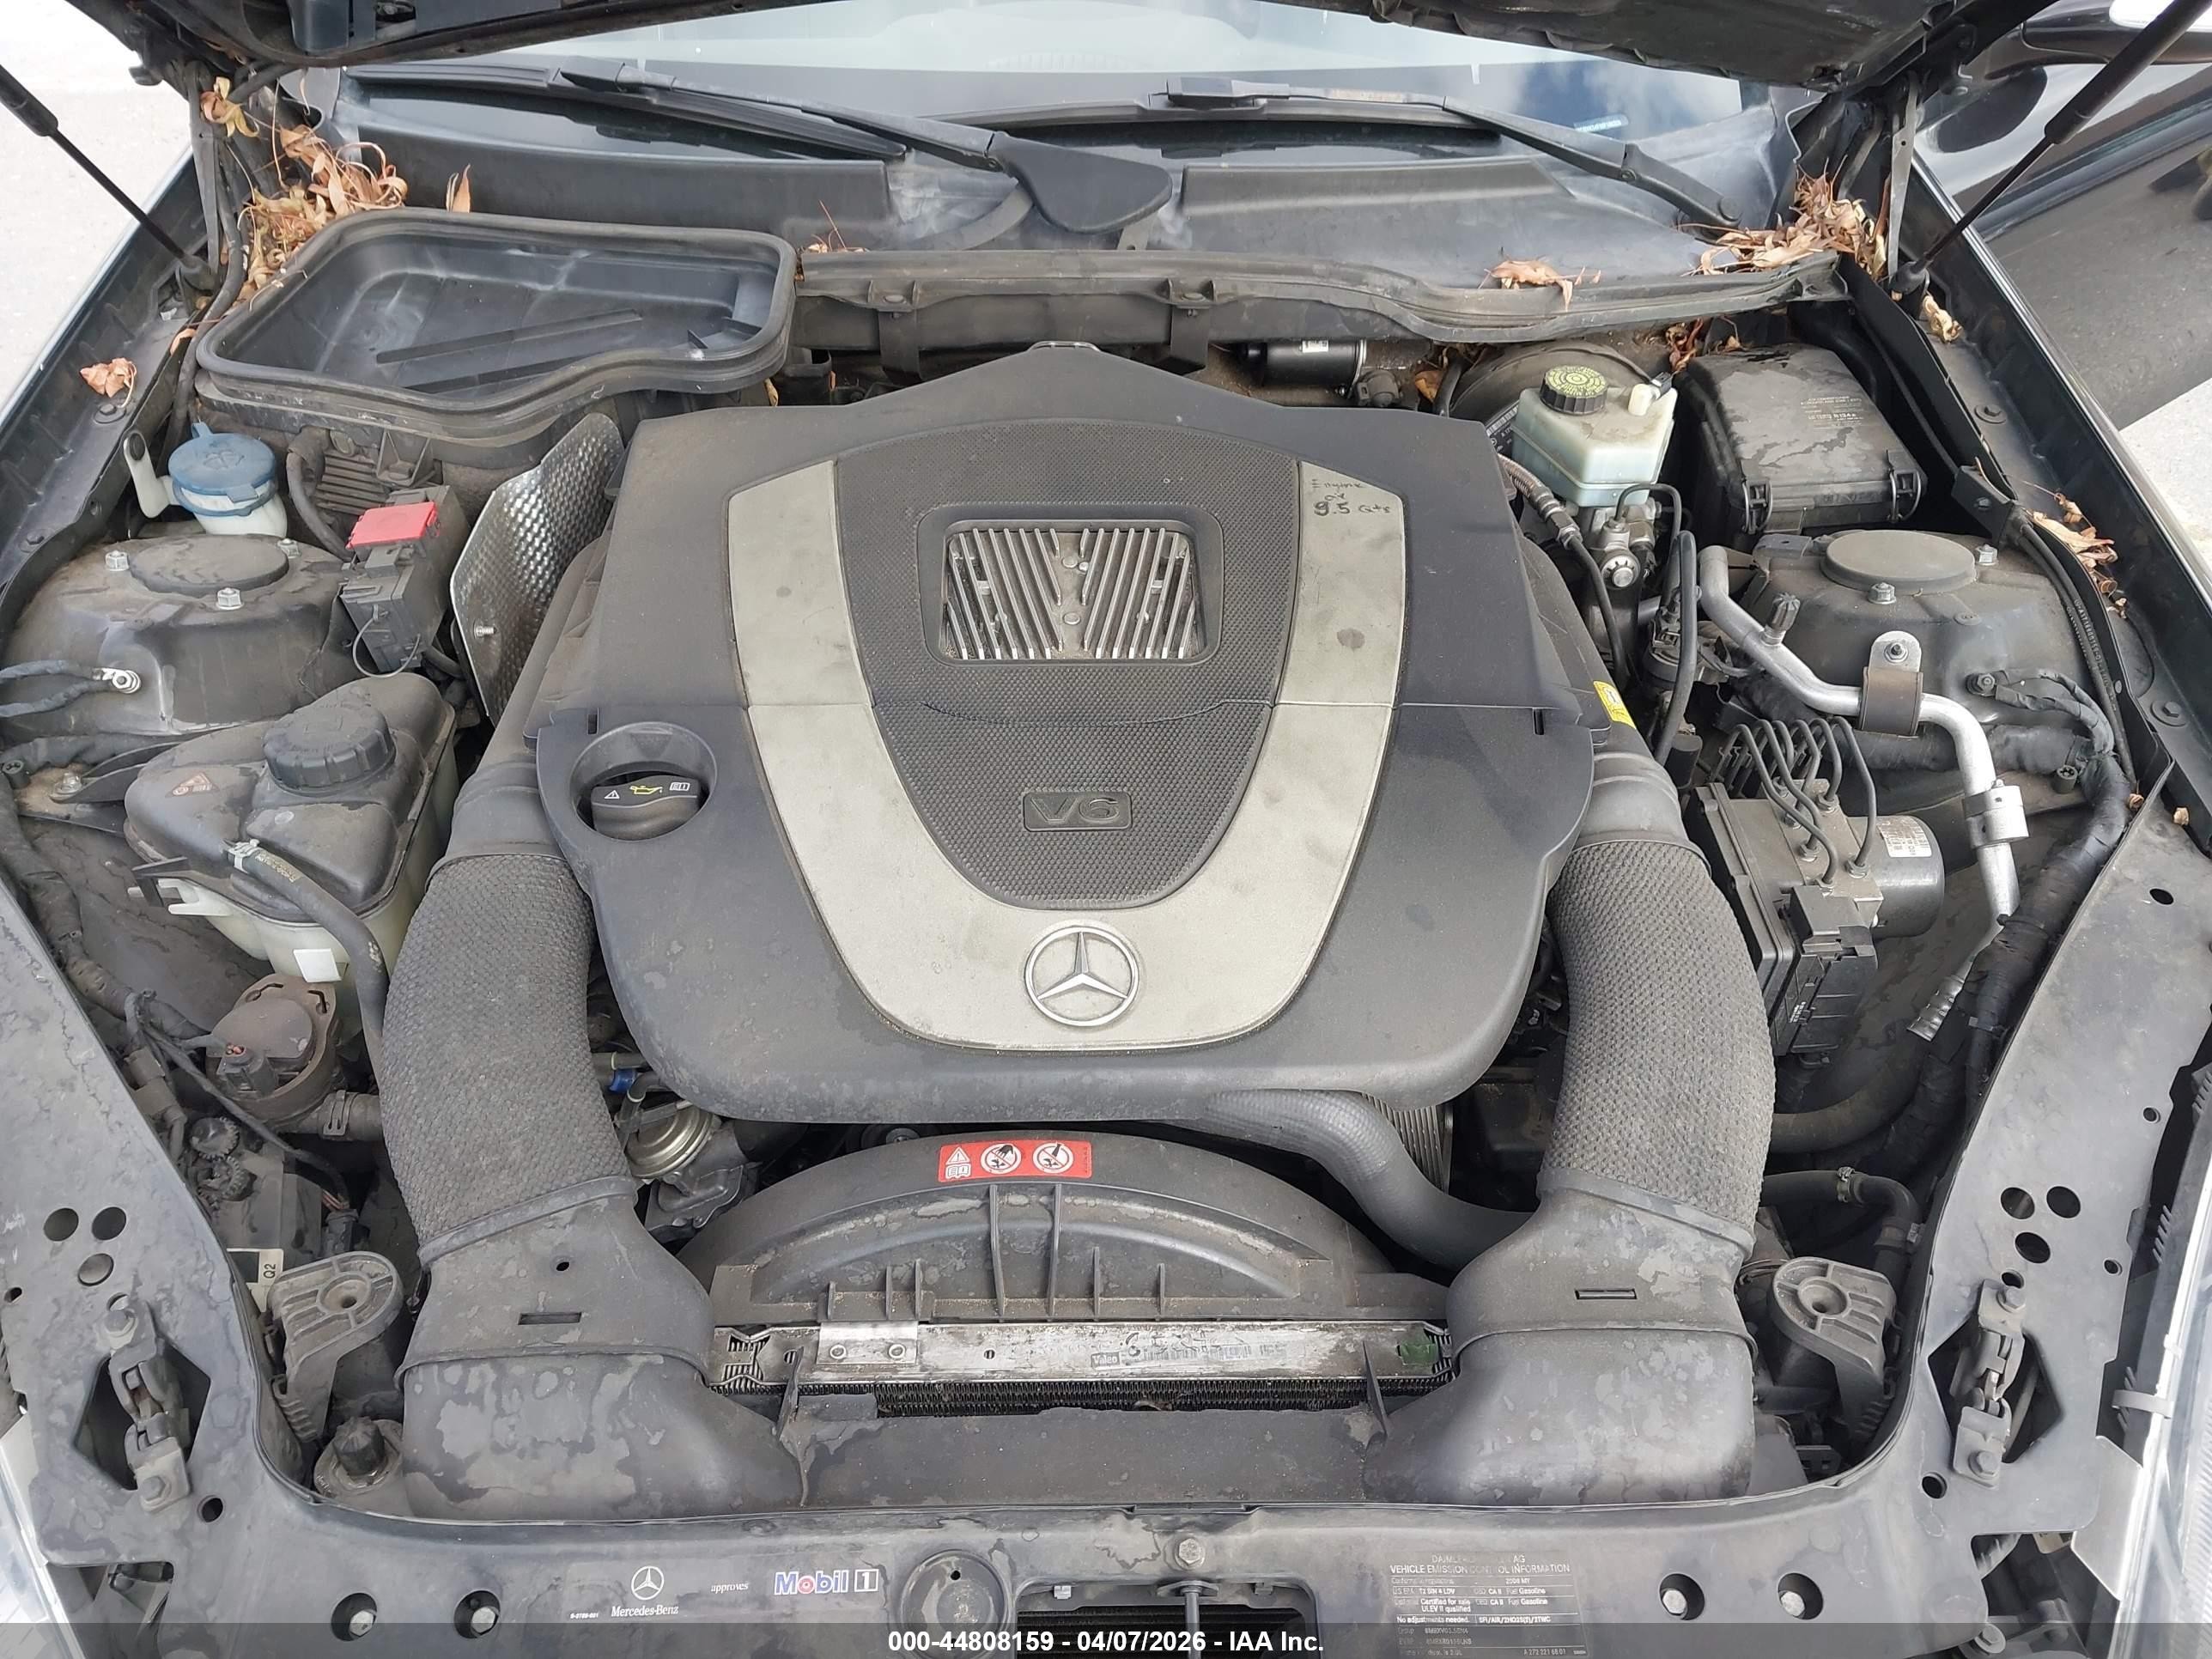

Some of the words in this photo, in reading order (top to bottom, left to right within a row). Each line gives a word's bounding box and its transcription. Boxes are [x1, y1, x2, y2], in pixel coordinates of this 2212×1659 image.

[1313, 501, 1351, 516] 9.5
[1030, 797, 1120, 823] V6
[263, 1263, 276, 1279] Q2
[1390, 1565, 1425, 1574] VEHICLE
[1426, 1565, 1468, 1574] EMISSION
[1469, 1565, 1510, 1574] CONTOL
[1511, 1563, 1571, 1574] INFORMATION
[710, 1582, 750, 1595] approves
[774, 1570, 849, 1595] Mobil
[611, 1604, 679, 1618] Mercedes-Benz
[1445, 1605, 1471, 1613] qualified
